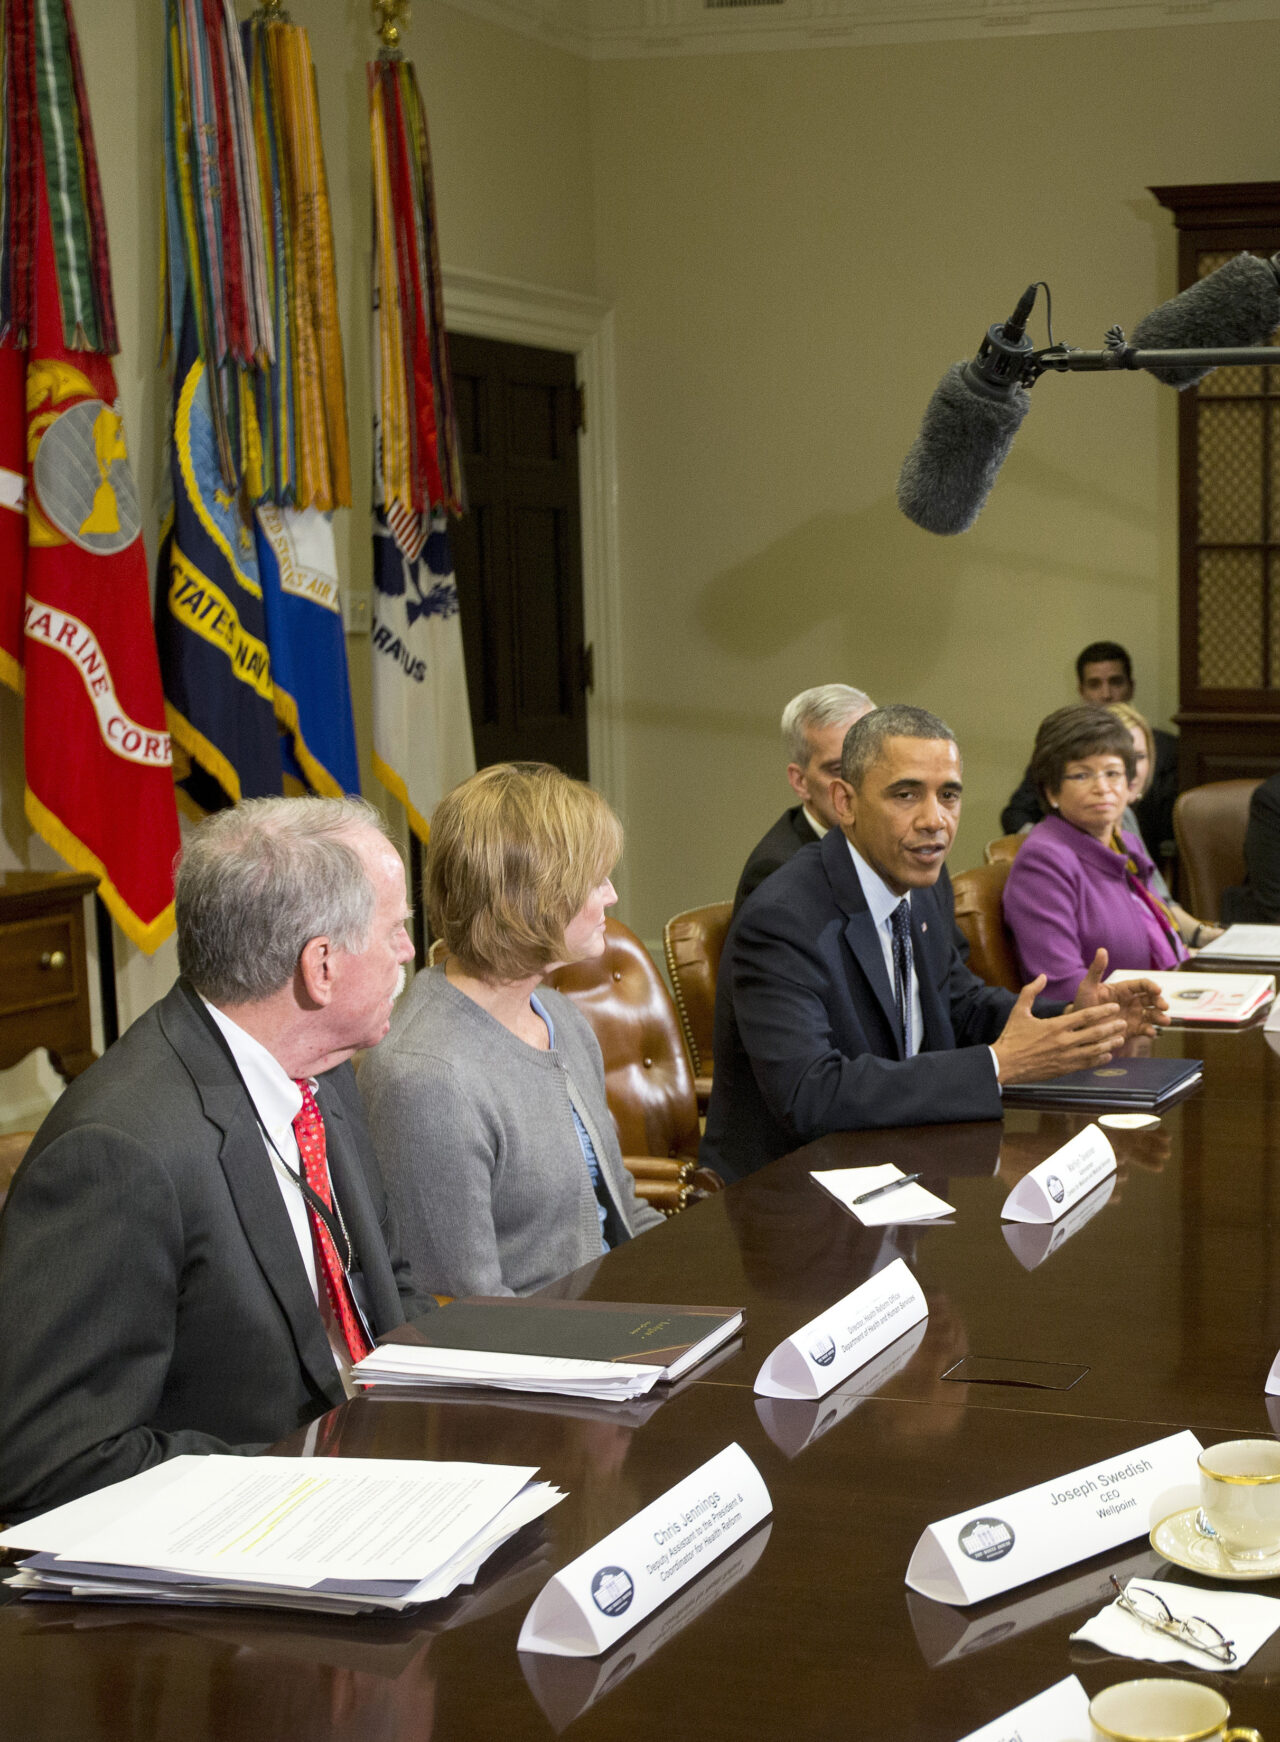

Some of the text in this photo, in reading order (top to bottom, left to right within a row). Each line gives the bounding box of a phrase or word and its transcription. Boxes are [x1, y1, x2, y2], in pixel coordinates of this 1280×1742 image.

[170, 564, 235, 645] STATES
[306, 577, 332, 600] AIR
[1050, 1459, 1153, 1506] Joseph Swedish
[1096, 1497, 1137, 1519] Wellpoint
[1100, 1489, 1120, 1503] CEO
[646, 1493, 744, 1575] Deputy Assistant to the President &
[653, 1491, 721, 1546] Chris Jennings
[660, 1512, 743, 1582] Coordinator for Health Reform
